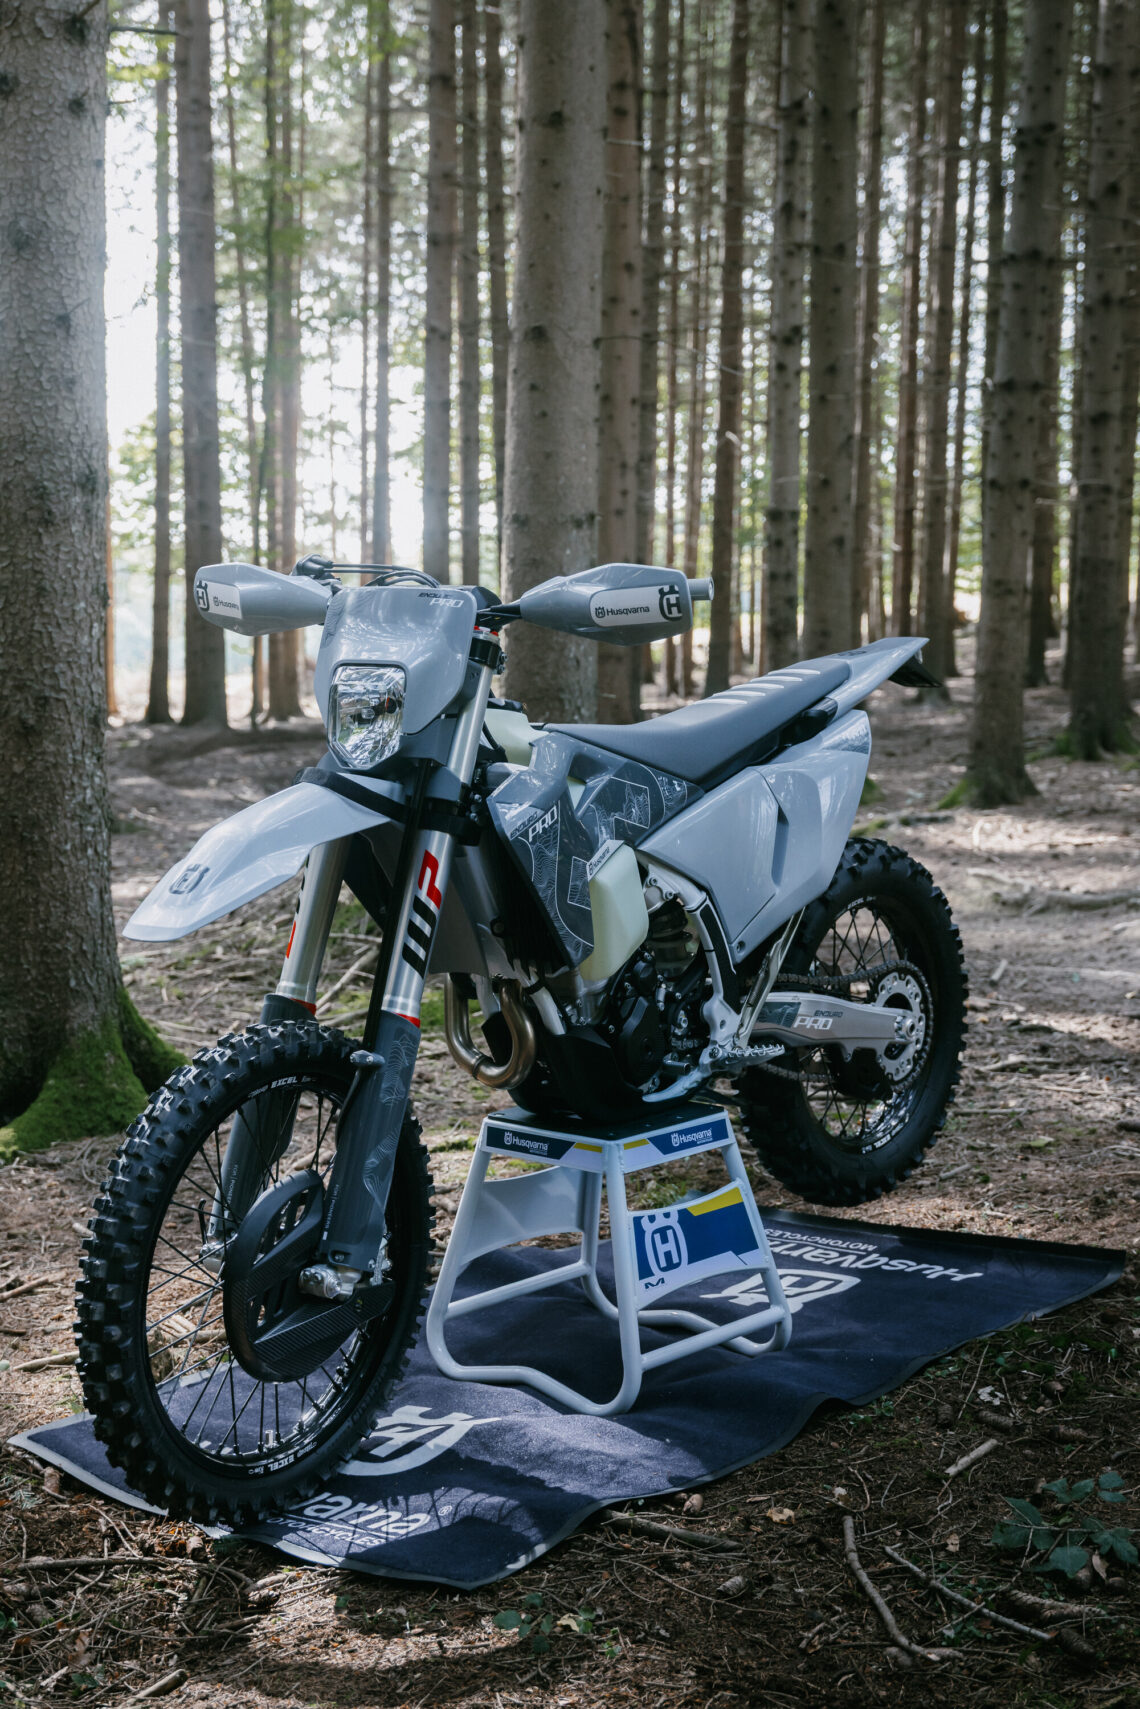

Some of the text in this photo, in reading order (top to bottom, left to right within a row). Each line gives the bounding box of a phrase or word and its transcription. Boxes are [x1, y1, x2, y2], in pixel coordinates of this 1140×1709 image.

[429, 598, 464, 608] PRO
[606, 605, 650, 617] Husqvarna
[510, 811, 538, 838] ENDURO
[528, 804, 557, 843] PRO
[814, 1010, 844, 1018] ENDURO
[793, 1016, 833, 1031] PRO
[271, 1076, 298, 1089] EXCEL
[512, 1136, 549, 1151] Husqvarna
[679, 1128, 713, 1144] Husqvarna
[765, 1228, 877, 1252] MOTORCYCLES
[769, 1239, 984, 1282] Husqvarn
[268, 1454, 295, 1472] EXCEL
[266, 1517, 388, 1547] OTORCYCLES
